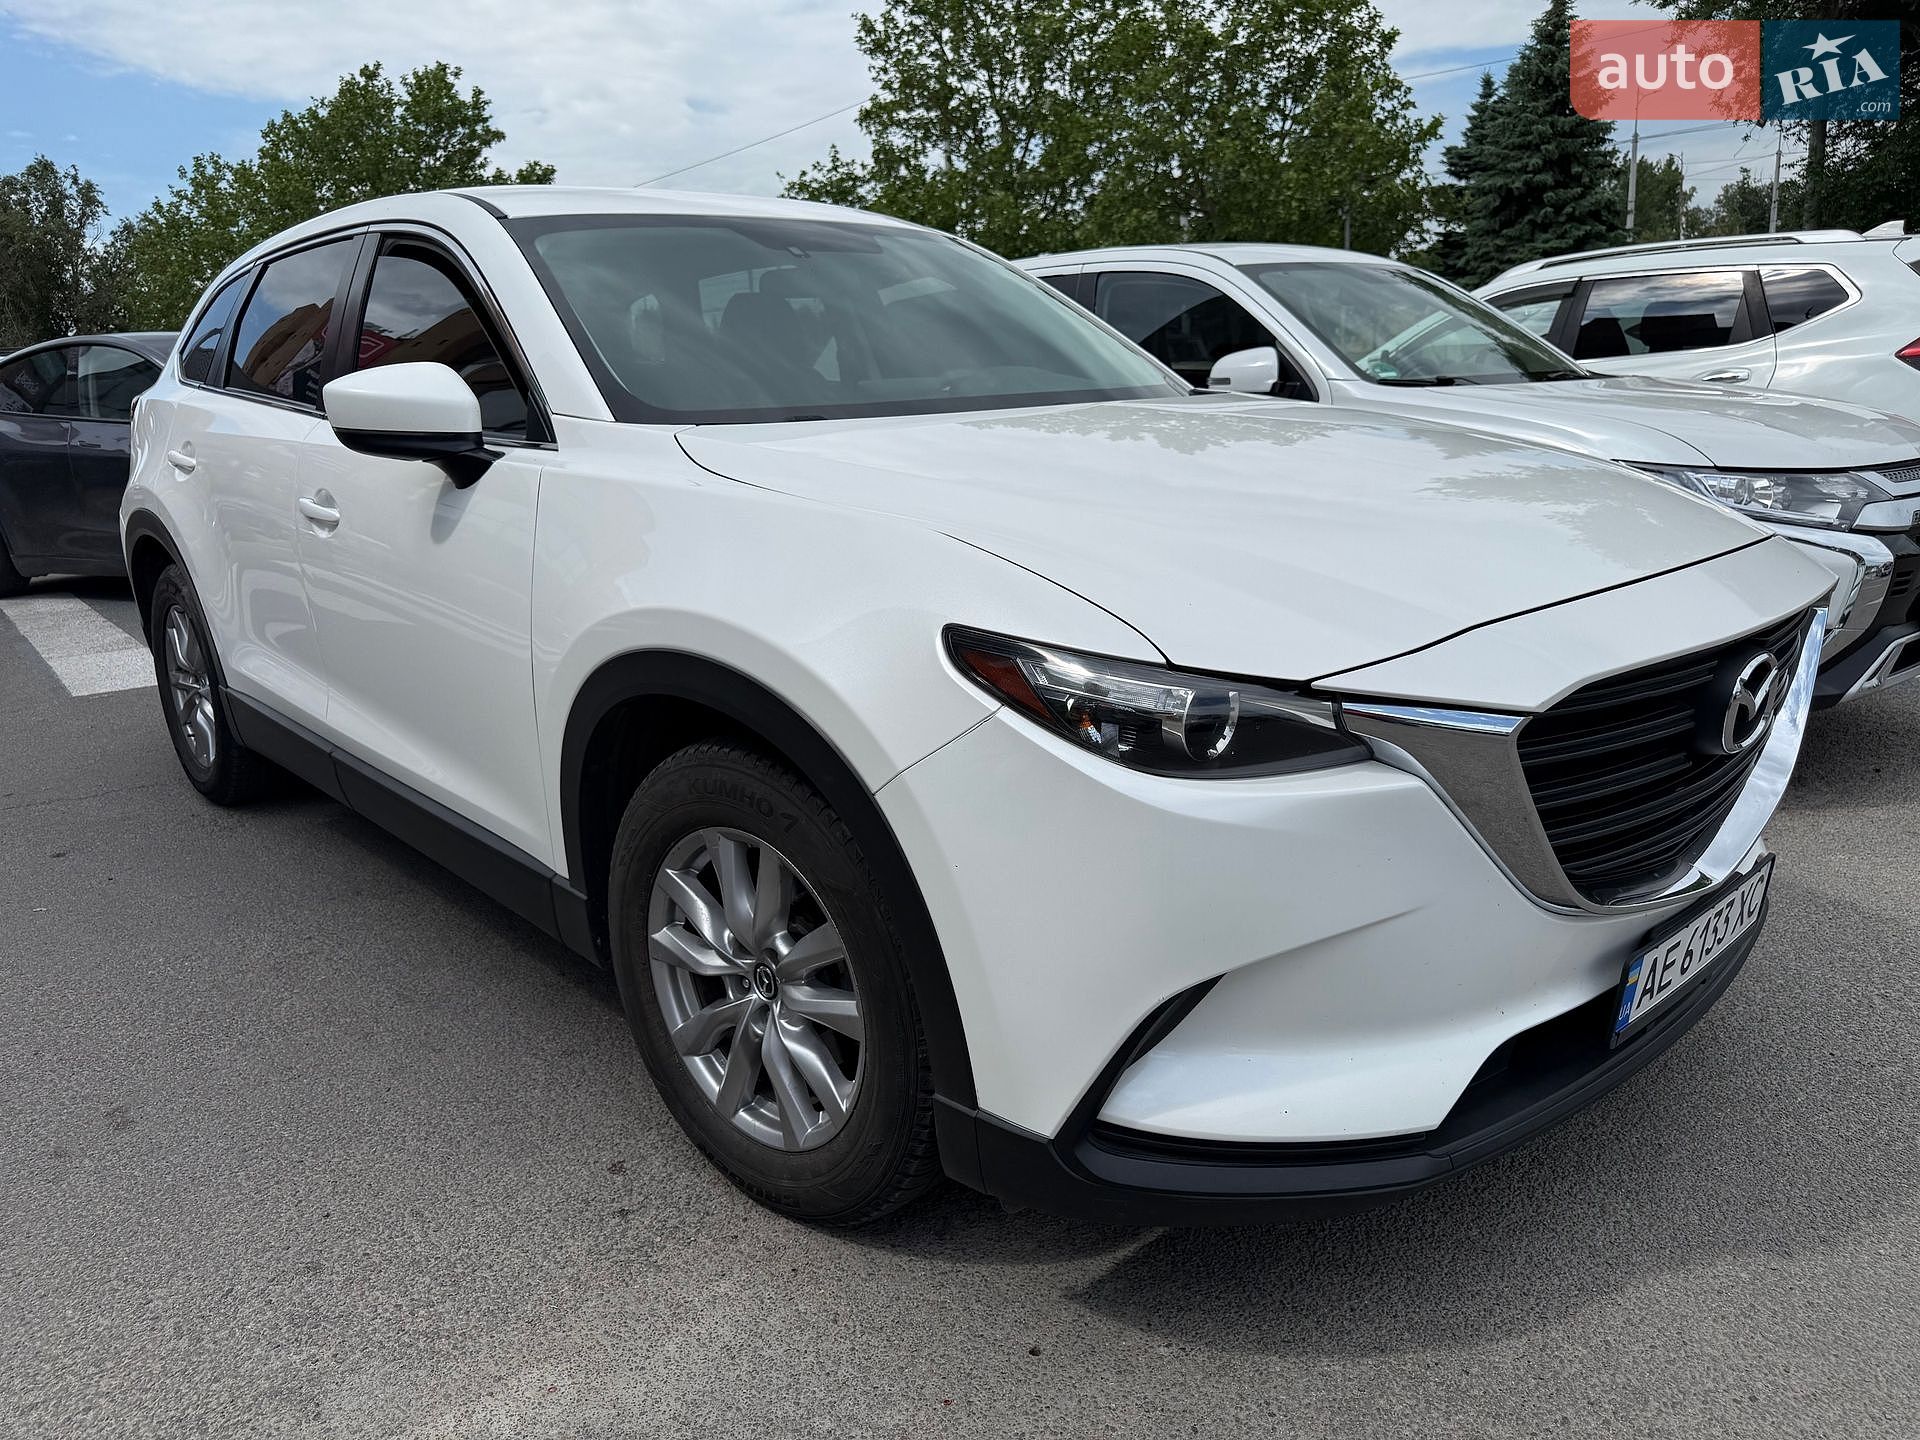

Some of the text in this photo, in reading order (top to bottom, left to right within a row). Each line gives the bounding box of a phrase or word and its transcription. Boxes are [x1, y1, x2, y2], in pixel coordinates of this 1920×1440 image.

[1636, 875, 1765, 1009] AE 6133 XC
